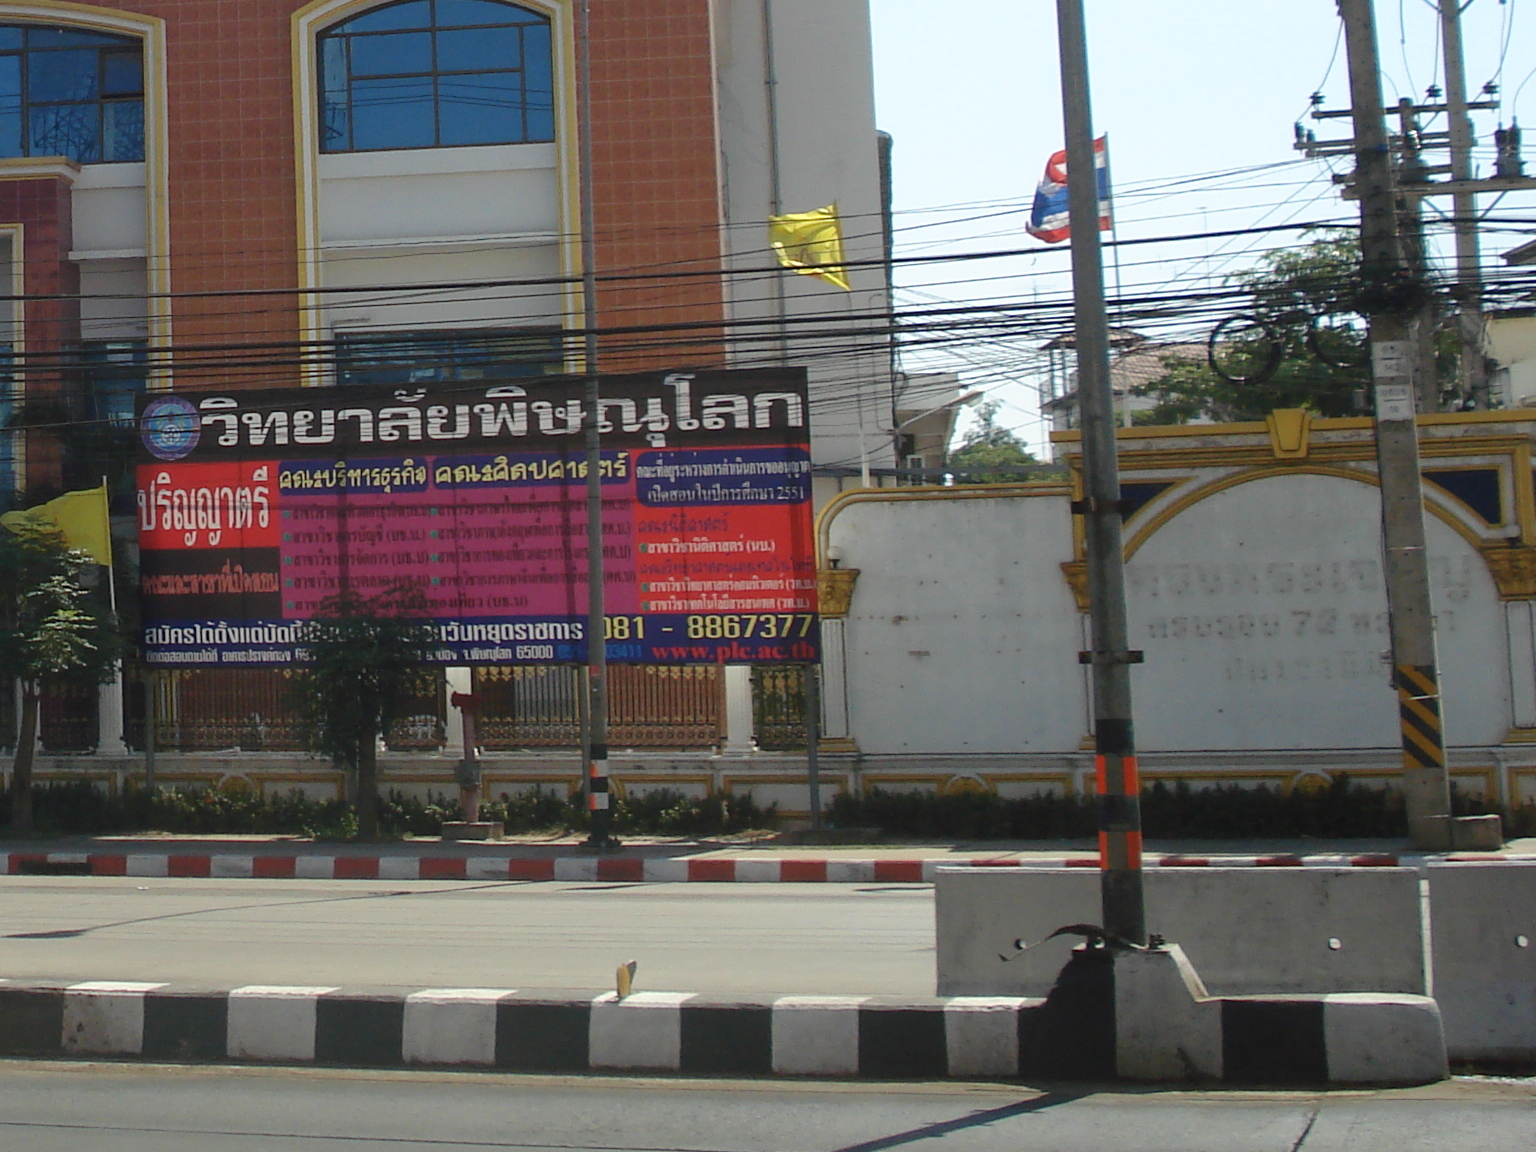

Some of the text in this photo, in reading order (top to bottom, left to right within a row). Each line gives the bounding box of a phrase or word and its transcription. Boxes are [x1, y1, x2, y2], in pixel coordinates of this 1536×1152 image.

[198, 373, 804, 448] วิทยาลัยพิษณุโลก
[279, 458, 426, 494] คณะบริหารธุรกิจ
[137, 466, 270, 546] ปริญญาตรี
[776, 485, 805, 501] 2551
[686, 614, 814, 640] 8867377
[515, 645, 554, 659] 65000
[651, 642, 816, 663] www.plc.ac.th
